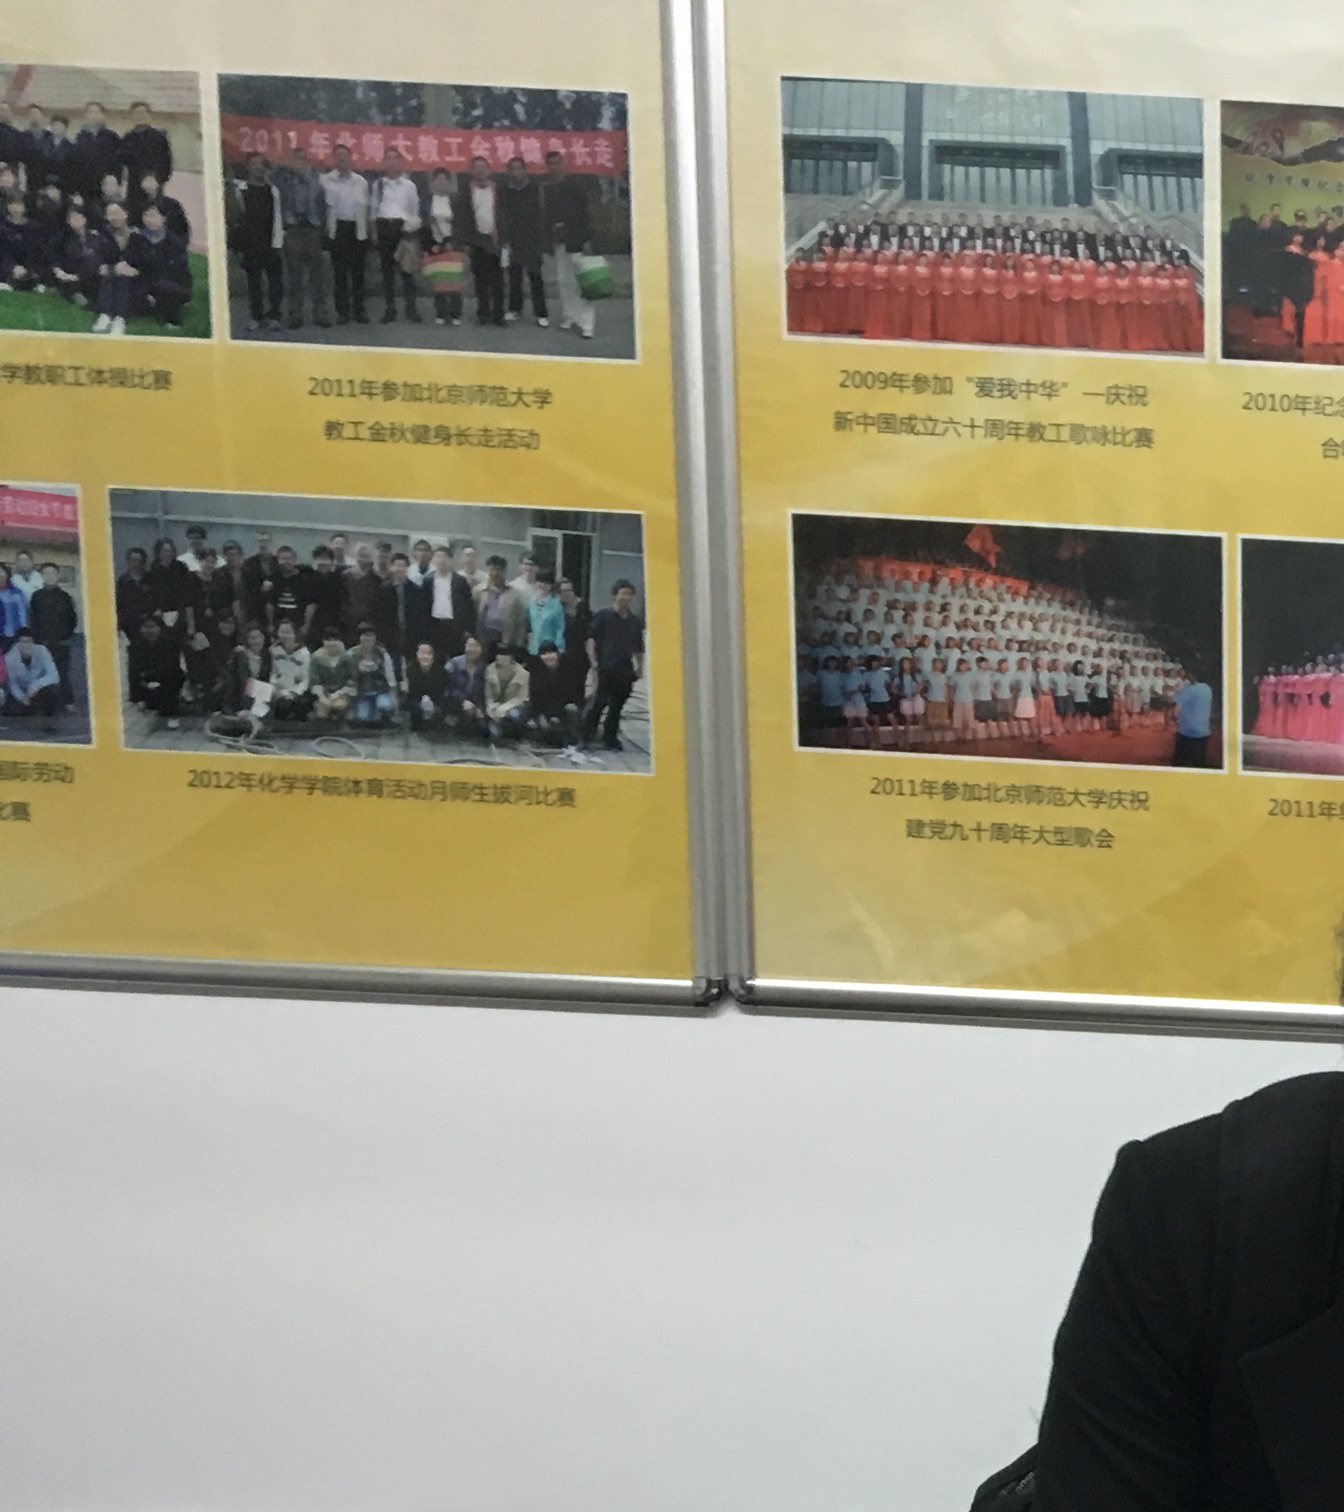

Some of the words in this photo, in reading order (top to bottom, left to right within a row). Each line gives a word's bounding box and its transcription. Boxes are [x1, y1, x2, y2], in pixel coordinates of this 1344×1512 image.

[307, 376, 553, 409] 2011年参加北京师范大学
[324, 419, 541, 450] 教工金秋健身长走活动
[833, 410, 1155, 448] 新中国成立六十周年教工歌咏比赛
[869, 776, 1150, 812] 2011年参加北京师范大学庆祝
[906, 818, 1116, 850] 建党九十周年大型歌会
